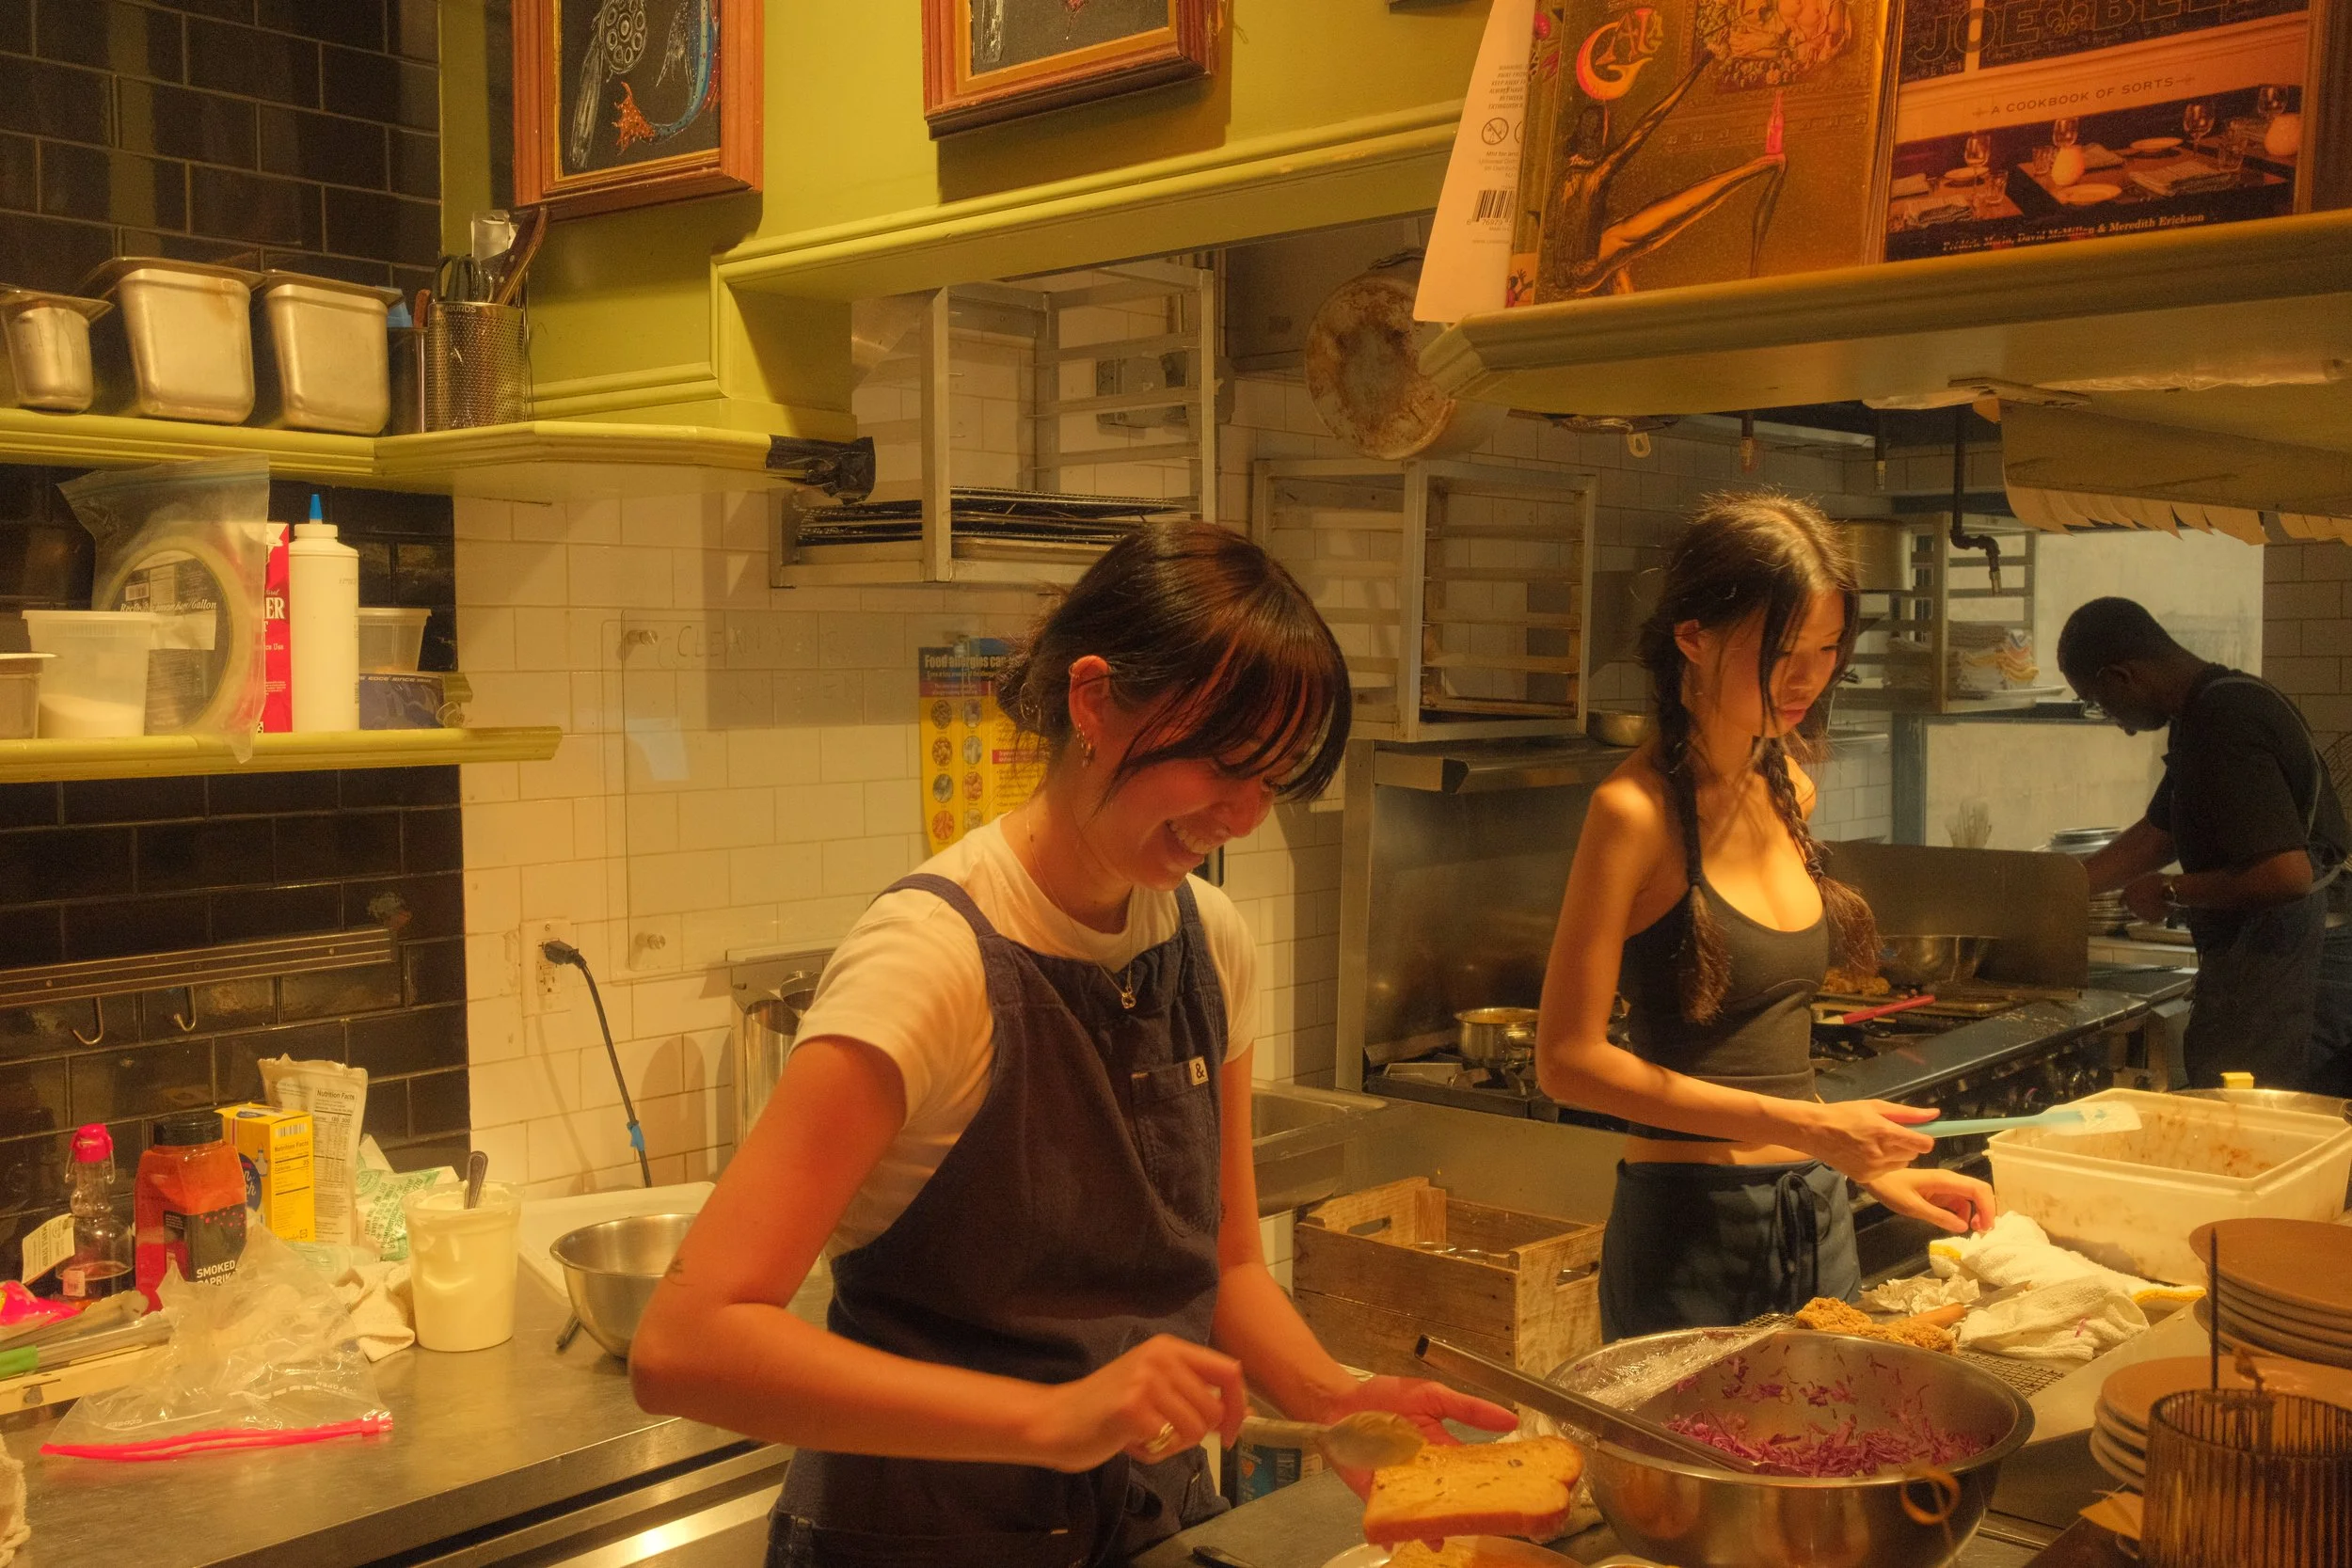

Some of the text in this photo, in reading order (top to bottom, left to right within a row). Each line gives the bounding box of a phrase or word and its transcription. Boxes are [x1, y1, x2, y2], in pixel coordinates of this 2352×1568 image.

[1991, 76, 2174, 115] A COOKBOOK OF SORTS
[2017, 230, 2045, 243] David
[2097, 224, 2106, 233] &
[2109, 217, 2155, 231] Meredith
[2158, 214, 2205, 227] Erickson
[924, 654, 948, 669] Food
[948, 654, 989, 670] allergies
[316, 1089, 341, 1099] Nutrition
[341, 1091, 356, 1101] Facts
[196, 1259, 236, 1279] SMOKED
